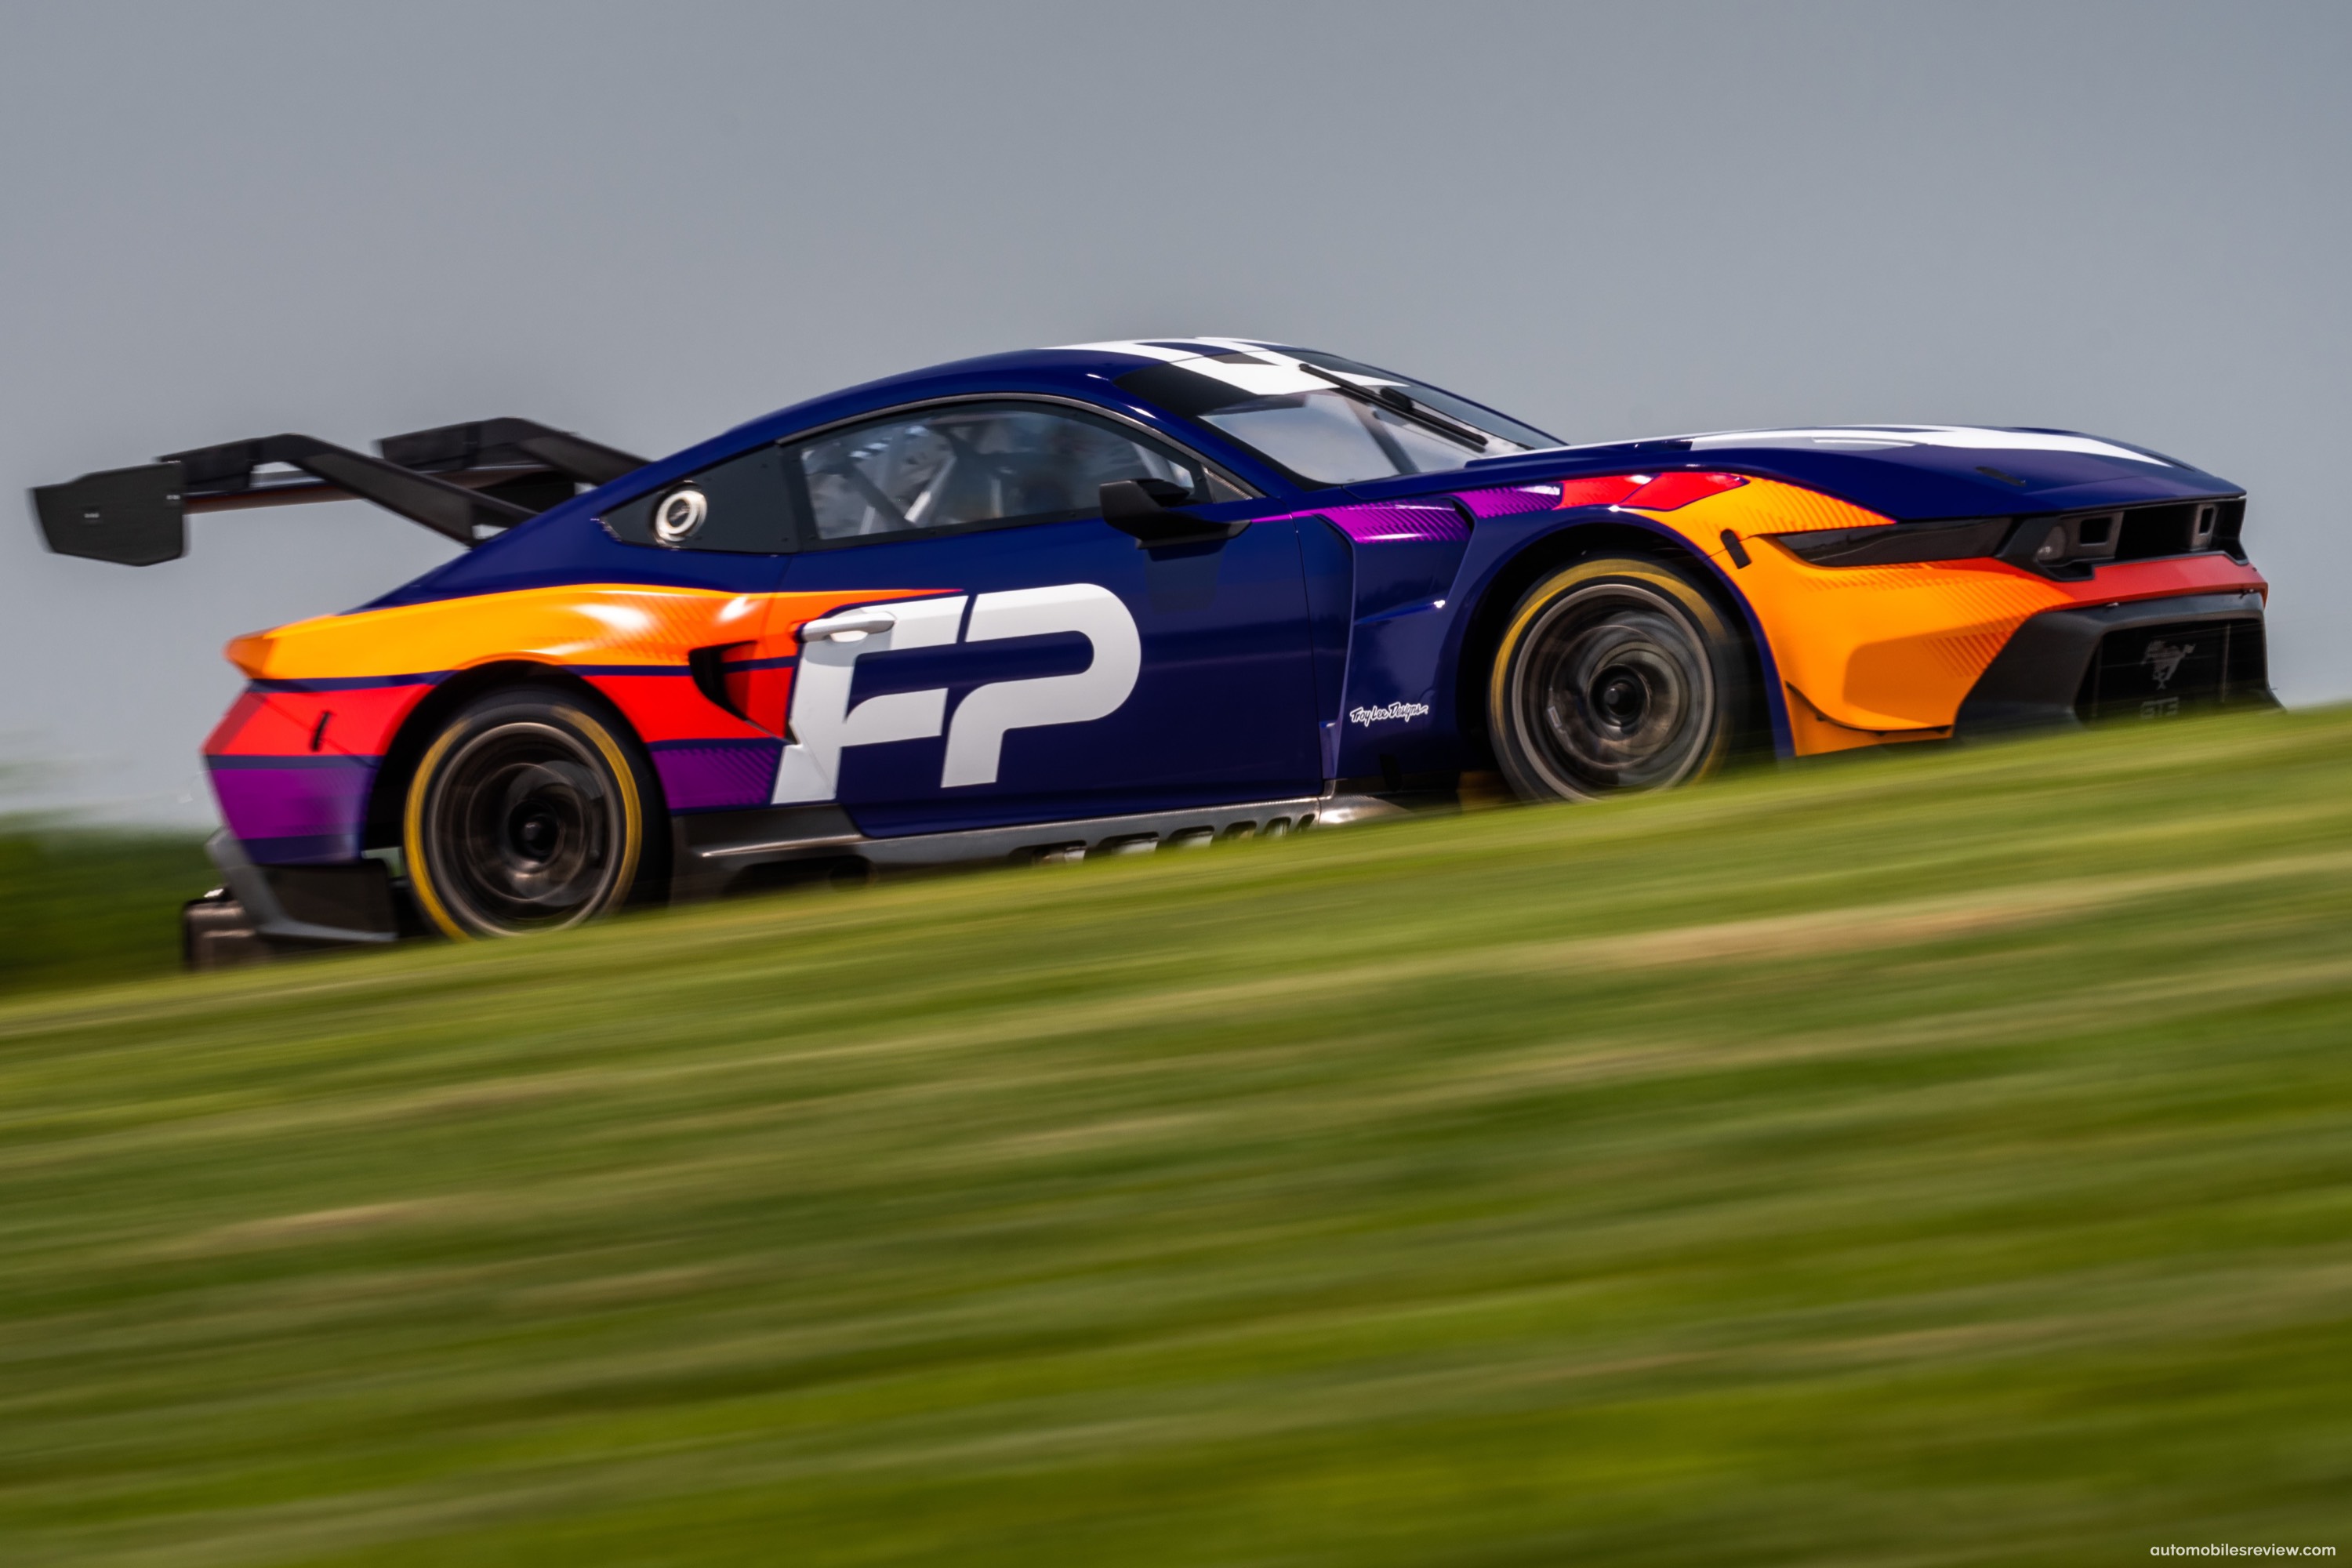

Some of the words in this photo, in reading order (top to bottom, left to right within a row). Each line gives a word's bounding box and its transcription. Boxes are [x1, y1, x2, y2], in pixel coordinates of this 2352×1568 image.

[771, 583, 1141, 804] FP
[1350, 706, 1371, 728] Troy
[1371, 706, 1388, 721] Lee
[1388, 702, 1428, 723] Designs
[2140, 697, 2179, 719] GT3
